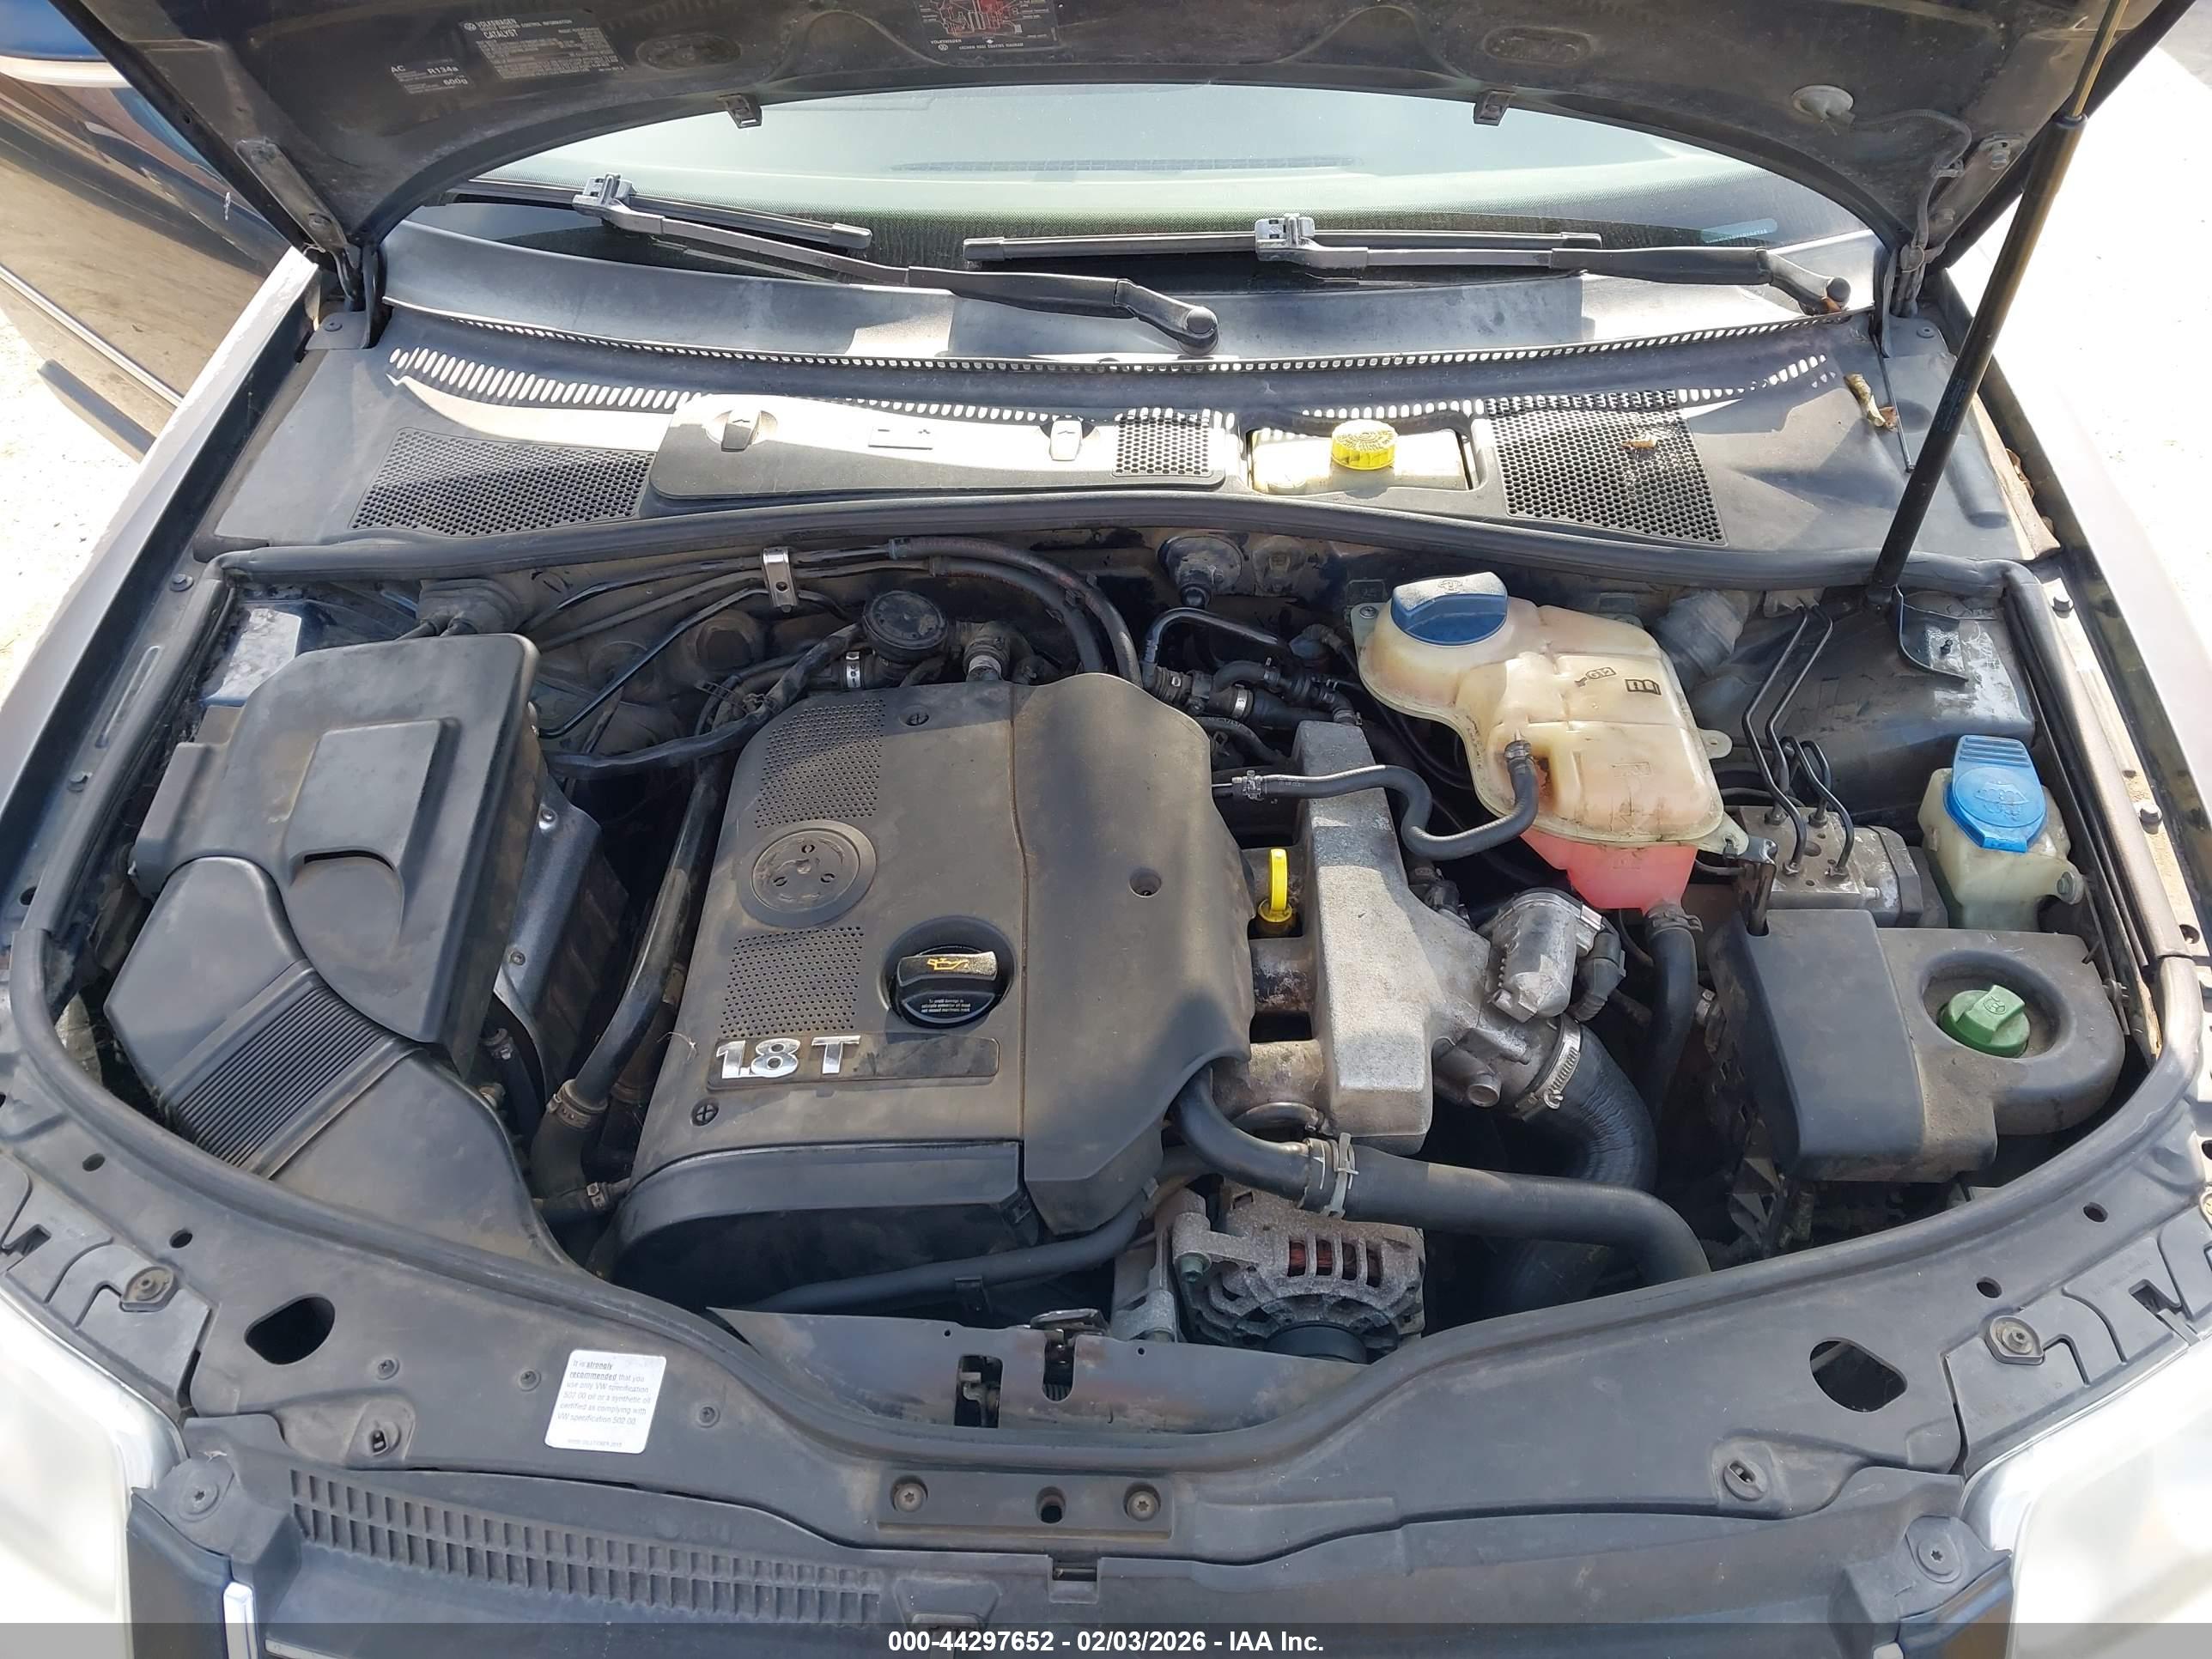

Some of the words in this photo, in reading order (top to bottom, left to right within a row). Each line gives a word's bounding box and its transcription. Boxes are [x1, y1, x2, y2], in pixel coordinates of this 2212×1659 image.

[477, 18, 517, 27] VOLKSWAGEN
[483, 29, 518, 39] CATALYST
[586, 1361, 612, 1370] strongly
[570, 1371, 617, 1381] recommended
[609, 1384, 648, 1393] specification
[598, 1406, 631, 1415] complying
[570, 1414, 611, 1423] specification
